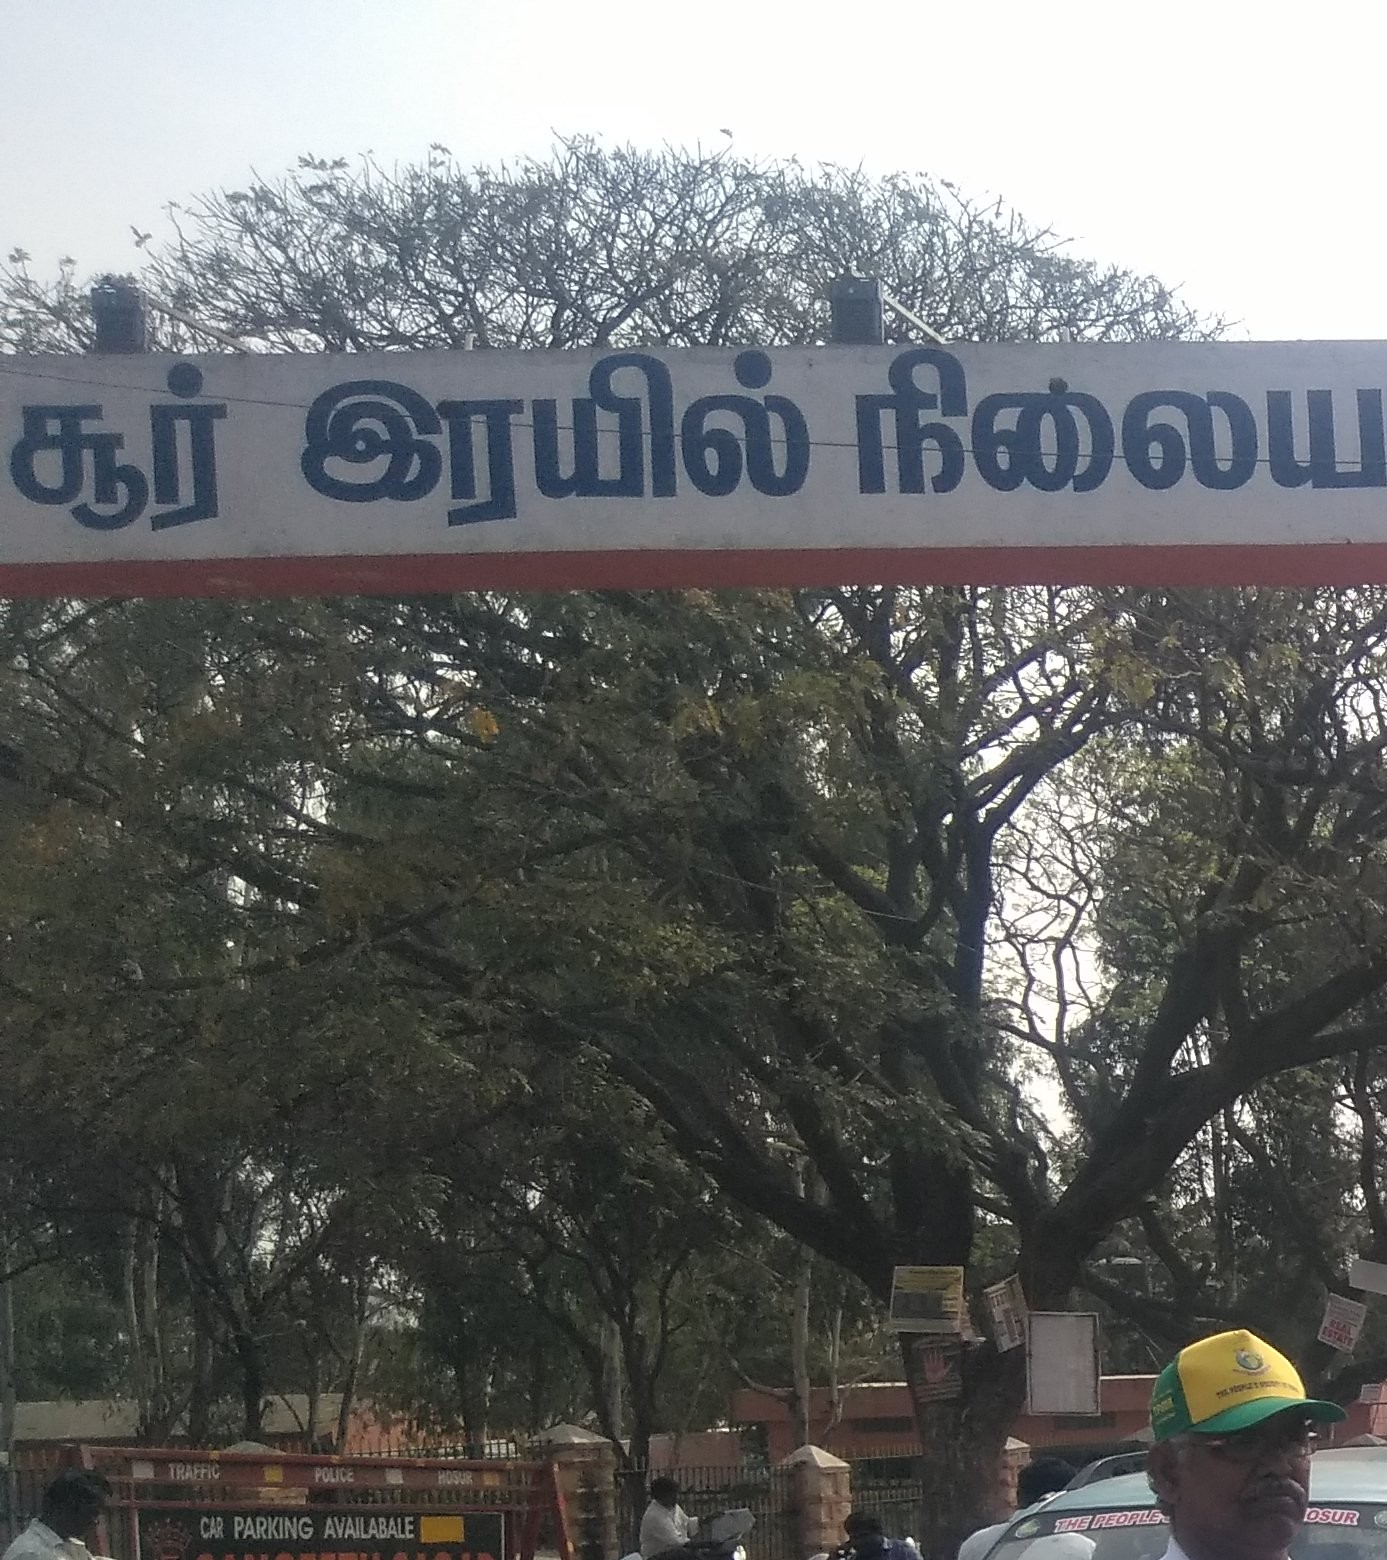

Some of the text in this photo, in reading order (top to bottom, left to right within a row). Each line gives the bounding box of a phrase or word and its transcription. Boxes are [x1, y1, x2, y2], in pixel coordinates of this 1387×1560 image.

[300, 351, 811, 527] இரயில்
[169, 1463, 473, 1486] TRAFFIC POLICE HOSUR
[1054, 1515, 1092, 1534] THE
[1303, 1506, 1360, 1526] OSUR
[200, 1516, 415, 1541] CAR PARKING AVAILABALE
